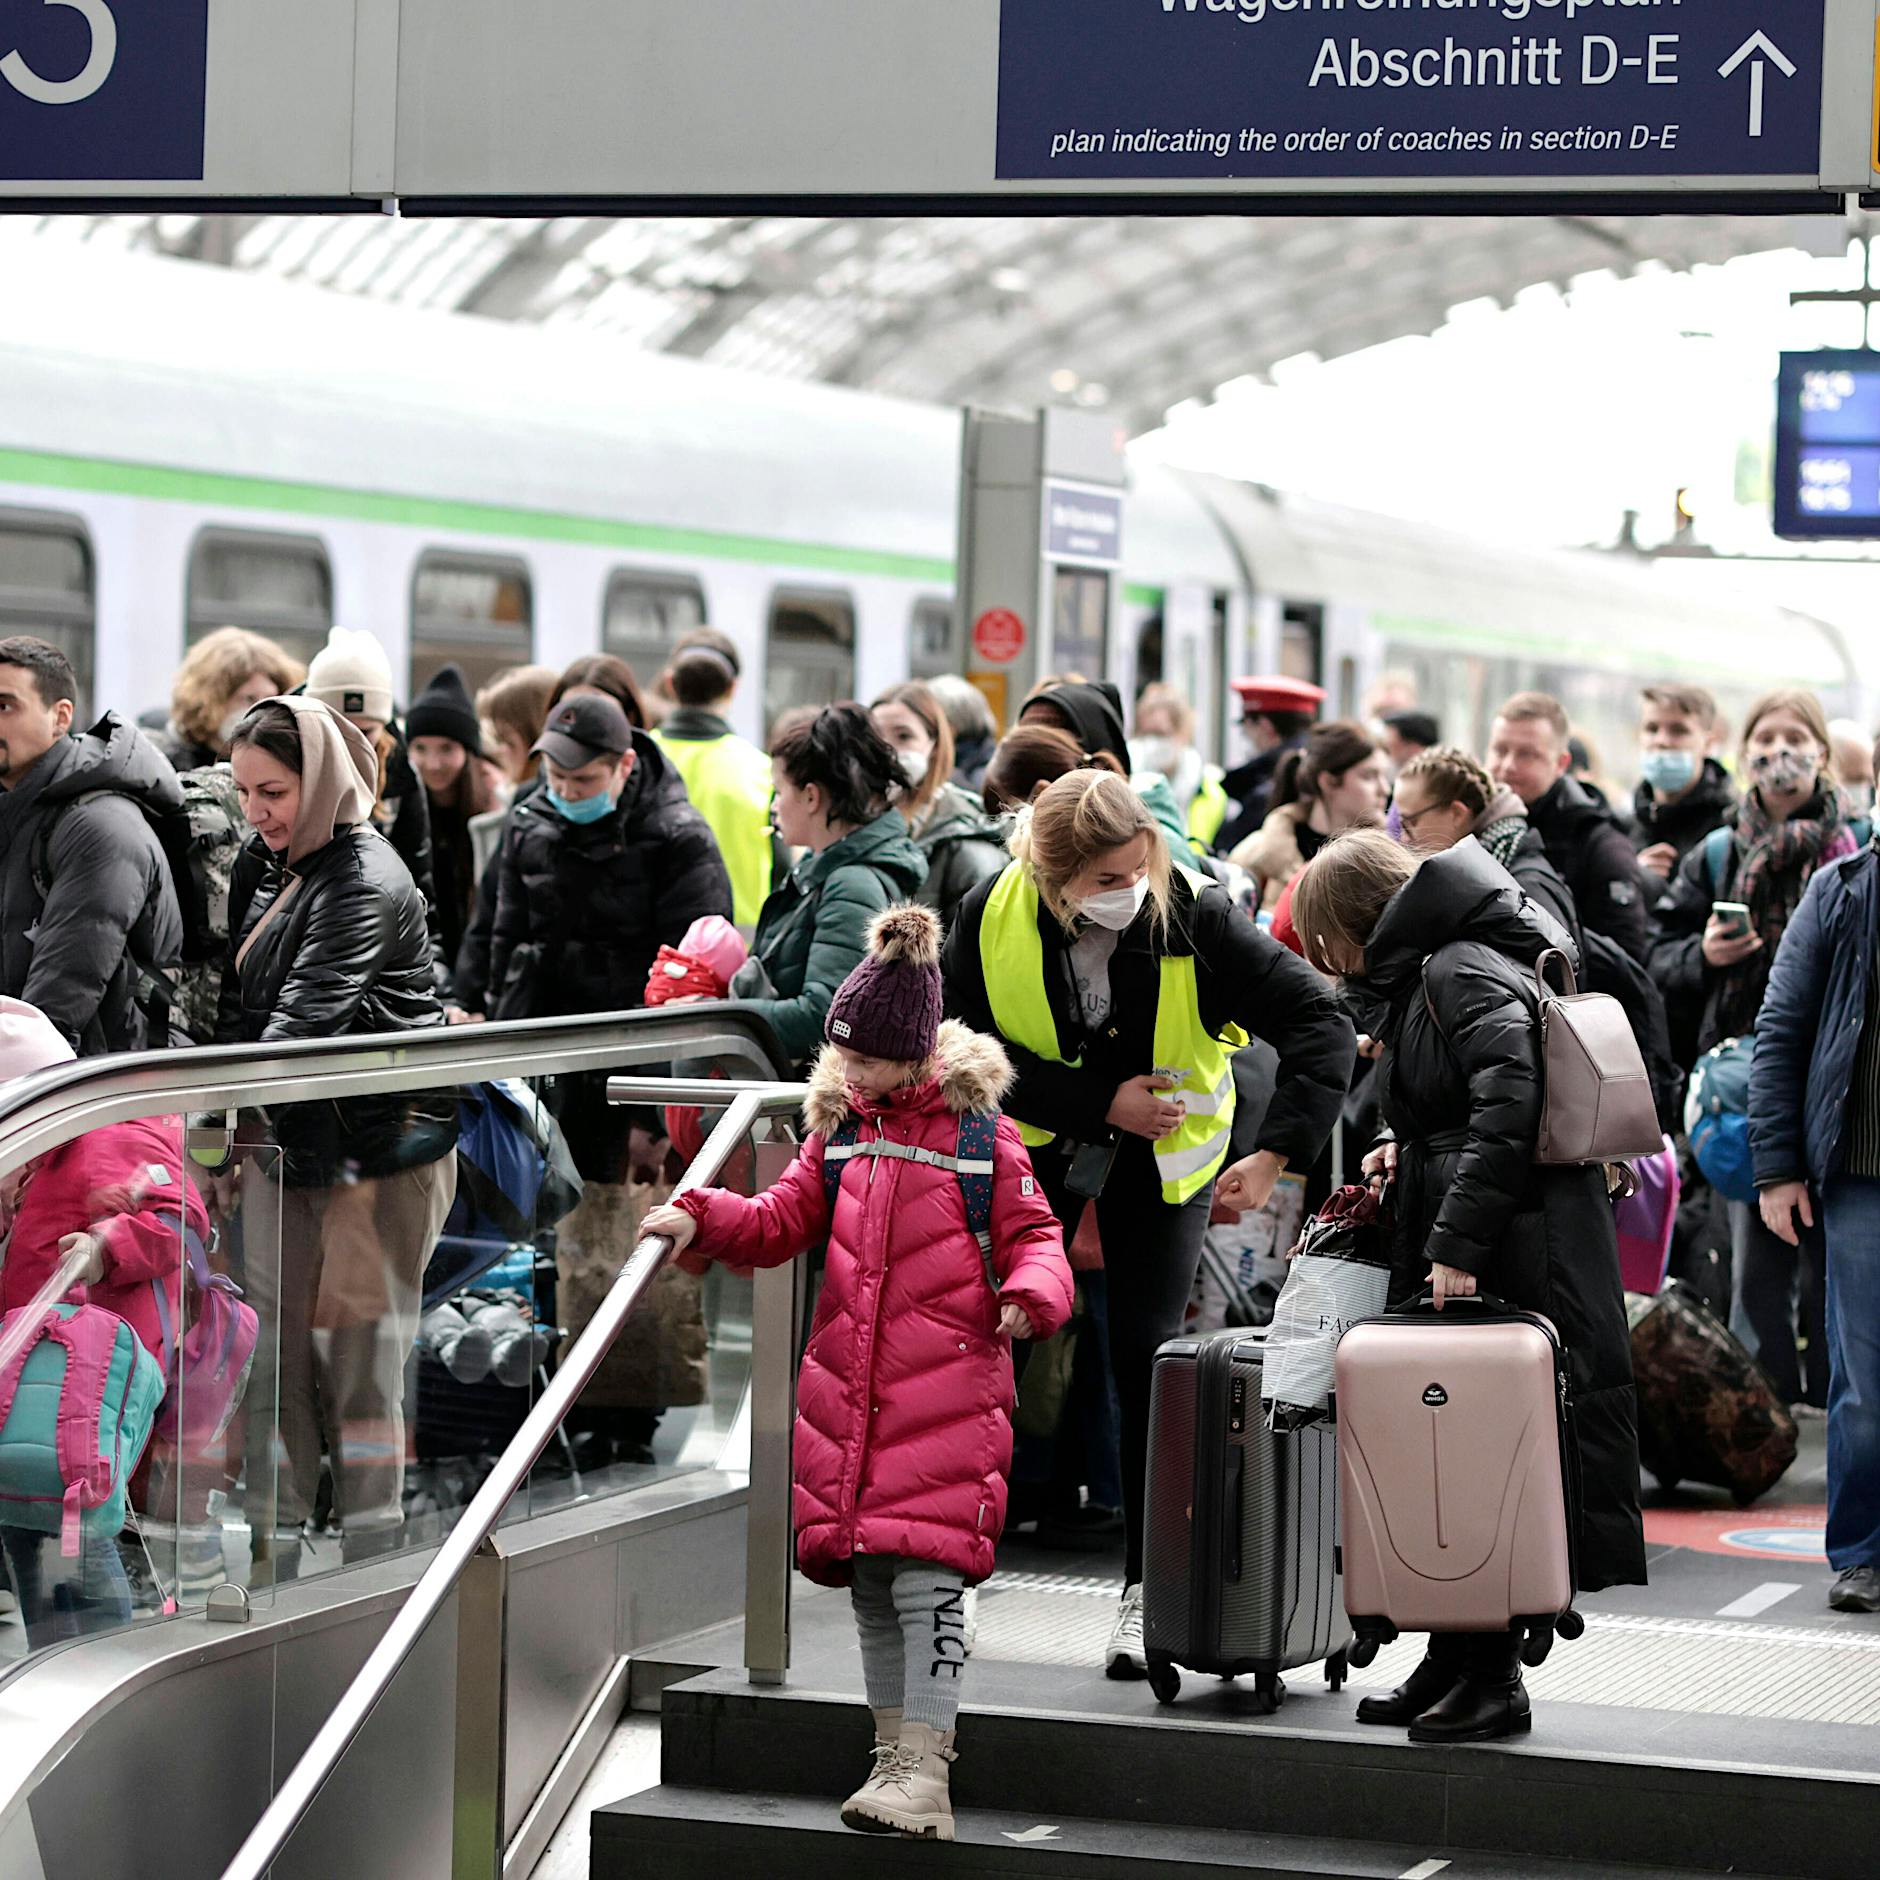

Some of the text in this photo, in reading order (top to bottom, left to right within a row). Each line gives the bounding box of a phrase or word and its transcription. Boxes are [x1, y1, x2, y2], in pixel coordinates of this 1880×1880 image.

[1308, 34, 1680, 88] Abschnitt D-E
[1050, 124, 1680, 158] plan indicating the order of coaches in section D-E
[930, 1586, 965, 1678] NICE
